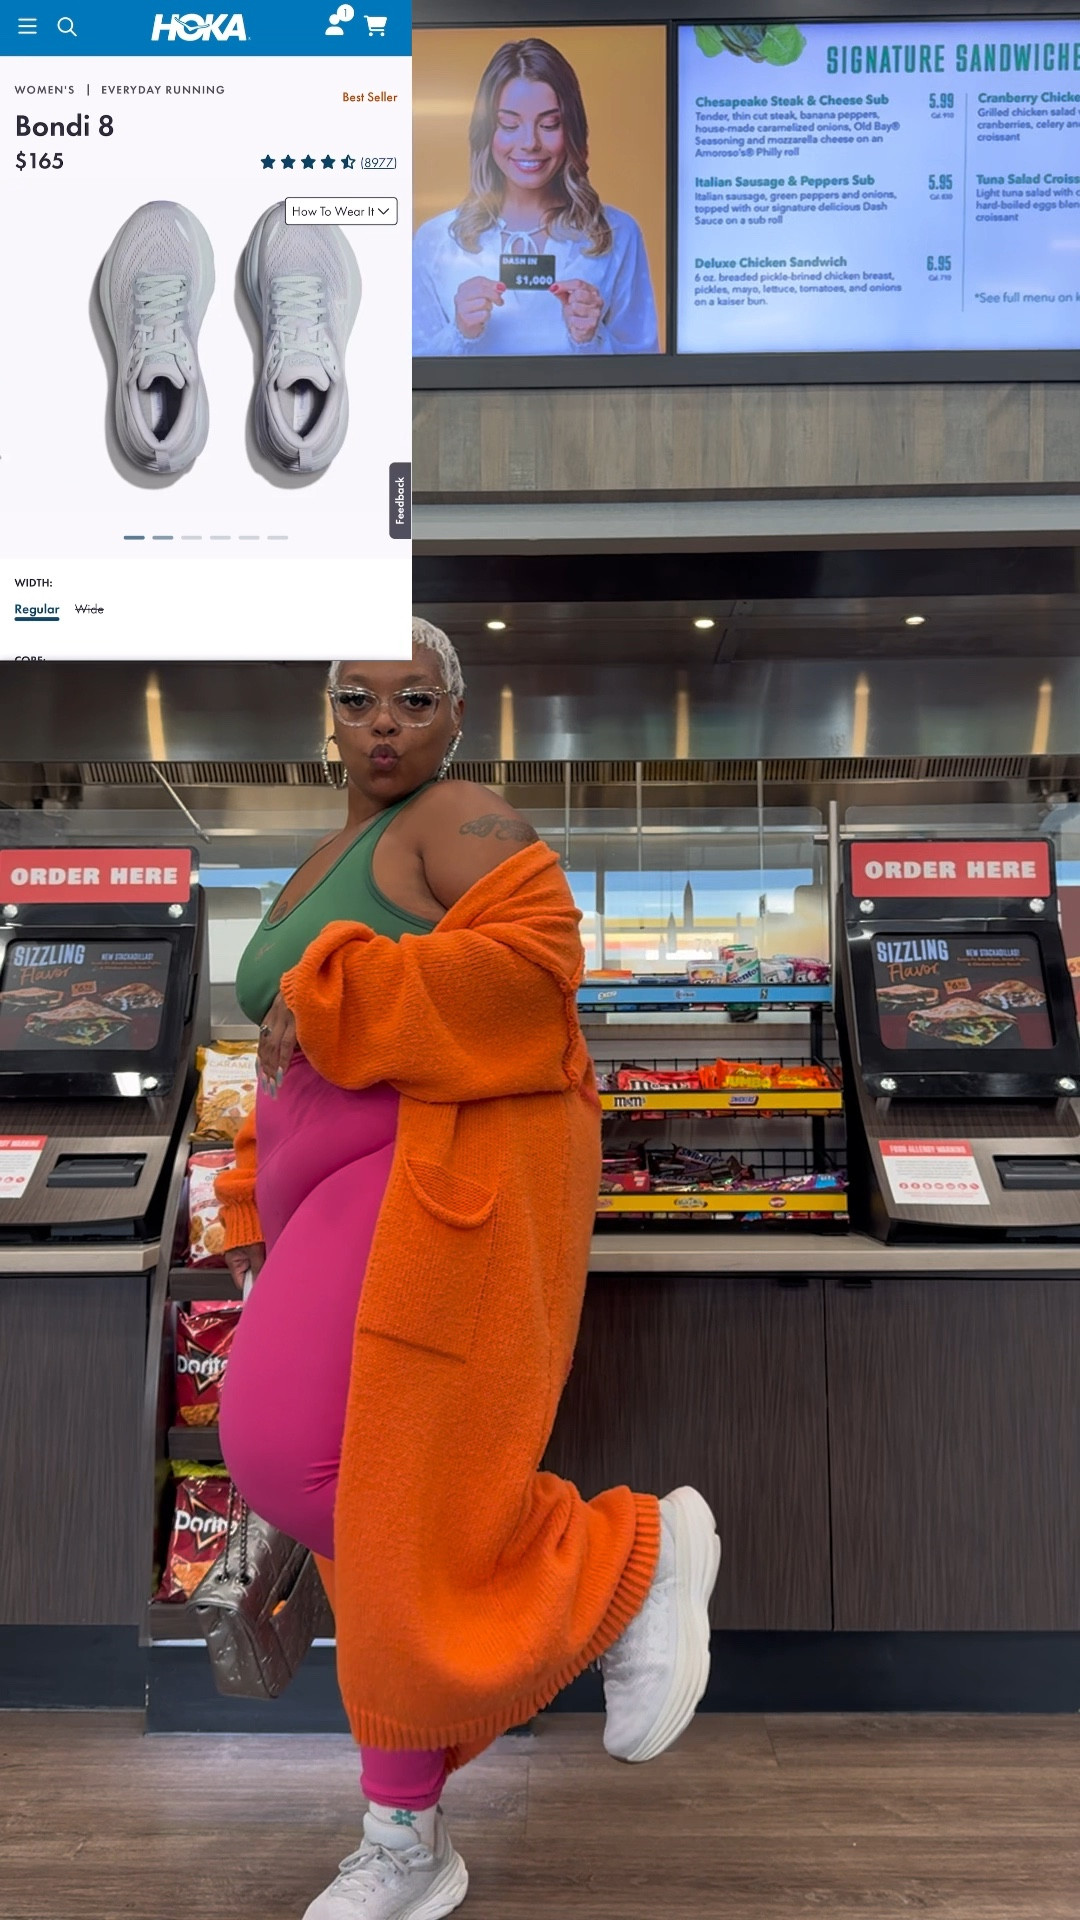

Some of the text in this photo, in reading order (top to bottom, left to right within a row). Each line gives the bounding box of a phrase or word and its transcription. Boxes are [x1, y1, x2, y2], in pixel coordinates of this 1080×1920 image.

[826, 44, 945, 74] SIGNATURE
[696, 93, 890, 110] Chesapeake Steak & Cheese Sub
[929, 93, 955, 109] 5.99
[978, 92, 1038, 106] Cranberry
[696, 110, 880, 122] Tender, thin cut steak, banana peppers,
[978, 108, 1010, 118] Grilled
[1012, 107, 1049, 117] chicken
[1050, 107, 1076, 117] salad
[695, 124, 755, 134] house-made
[757, 123, 815, 133] caramelized
[817, 123, 852, 133] onions,
[854, 122, 872, 132] Old
[977, 120, 1034, 130] cranberries,
[1036, 119, 1065, 131] celery
[695, 134, 884, 148] Seasoning and mozzarella cheese on an
[977, 132, 1021, 142] croissant
[756, 147, 783, 159] Philly
[784, 147, 800, 156] roll
[695, 174, 875, 189] Italian Sausage & Peppers Sub
[928, 174, 953, 191] 5.95
[976, 174, 1005, 185] Tuna
[1007, 173, 1041, 185] Salad
[695, 190, 898, 203] Italian sausage, green peppers and onions,
[976, 189, 1001, 200] Light
[1002, 189, 1024, 198] tuna
[1026, 188, 1051, 198] salad
[1053, 187, 1074, 198] with
[695, 202, 888, 214] topped with our signature delicious Dash
[976, 201, 1031, 210] hard-boiled
[1033, 201, 1057, 212] eggs
[695, 215, 783, 226] Sauce on a sub roll
[975, 213, 1019, 223] croissant
[502, 257, 538, 266] DASH IN
[695, 256, 847, 269] Deluxe Chicken Sandwich
[927, 256, 952, 272] 6.95
[515, 274, 554, 287] $1,000
[695, 271, 895, 284] 6 oz. breaded pickle-brined chicken breast,
[695, 284, 902, 296] pickles, mayo, lettuce, tomatoes, and onions
[717, 297, 745, 306] kaiser
[747, 297, 769, 306] bun.
[1003, 292, 1020, 303] full
[1023, 295, 1056, 303] menu
[1058, 294, 1073, 303] on
[11, 867, 178, 886] ORDER HERE
[865, 861, 1037, 880] ORDER HERE
[14, 944, 86, 967] SIZZLING
[876, 939, 949, 963] SIZZLING
[20, 966, 73, 986] Flavor
[887, 962, 940, 983] Flavor
